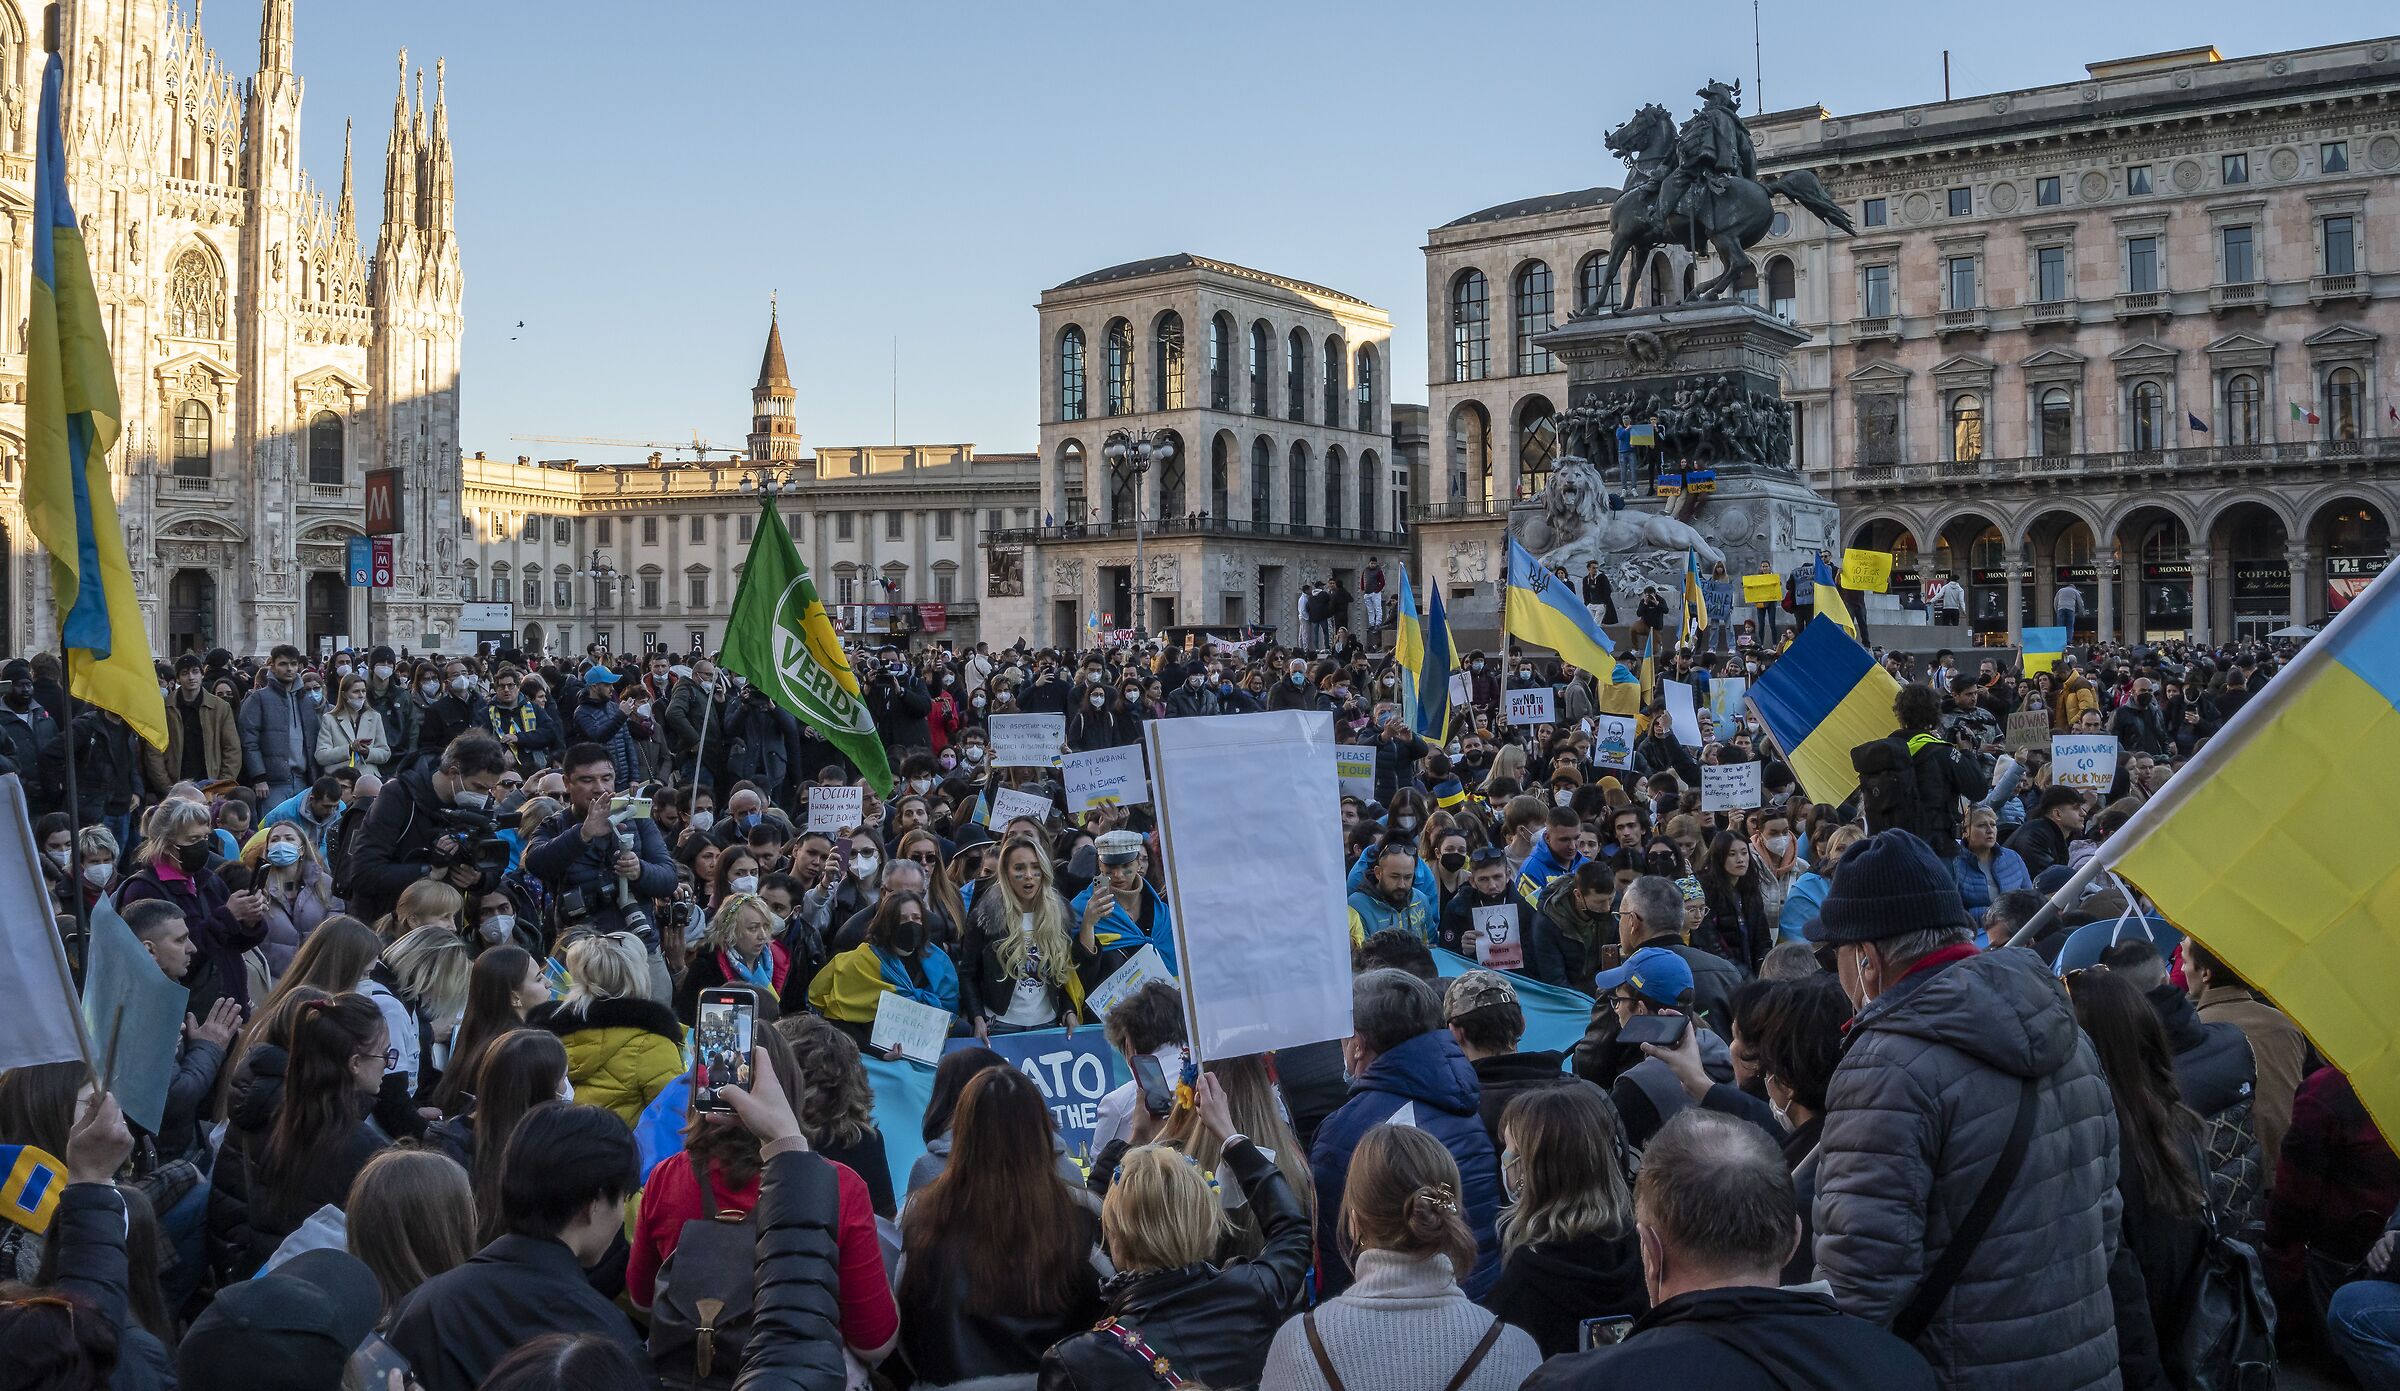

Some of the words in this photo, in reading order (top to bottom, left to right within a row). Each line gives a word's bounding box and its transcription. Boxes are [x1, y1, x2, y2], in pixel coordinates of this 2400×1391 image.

[369, 486, 391, 520] M
[2237, 570, 2291, 579] COPPOL
[782, 636, 861, 727] VERDI
[1511, 697, 1523, 706] SAY
[1523, 693, 1536, 705] NO
[1536, 696, 1544, 705] TO
[1512, 704, 1544, 717] PUTIN
[2008, 714, 2025, 730] NO
[2026, 711, 2048, 728] WAR
[1336, 751, 1371, 761] PLEASE
[2055, 744, 2091, 757] RUSSIAN
[1063, 759, 1084, 769] WAR
[1085, 759, 1093, 767] IN
[1095, 753, 1127, 764] UKRAINE
[2077, 758, 2094, 771] GO
[1089, 767, 1102, 776] IS
[1349, 766, 1372, 775] OUR
[1067, 783, 1088, 794] WAR
[1089, 782, 1096, 791] IN
[1097, 775, 1128, 788] EUROPE
[2059, 772, 2089, 784] FUCK
[812, 787, 857, 800] РОССИЯ
[814, 814, 835, 826] НЕТ
[1488, 947, 1510, 955] Putin
[1481, 959, 1521, 967] Assassino
[1008, 1050, 1106, 1100] ATO
[1050, 1103, 1099, 1129] THE
